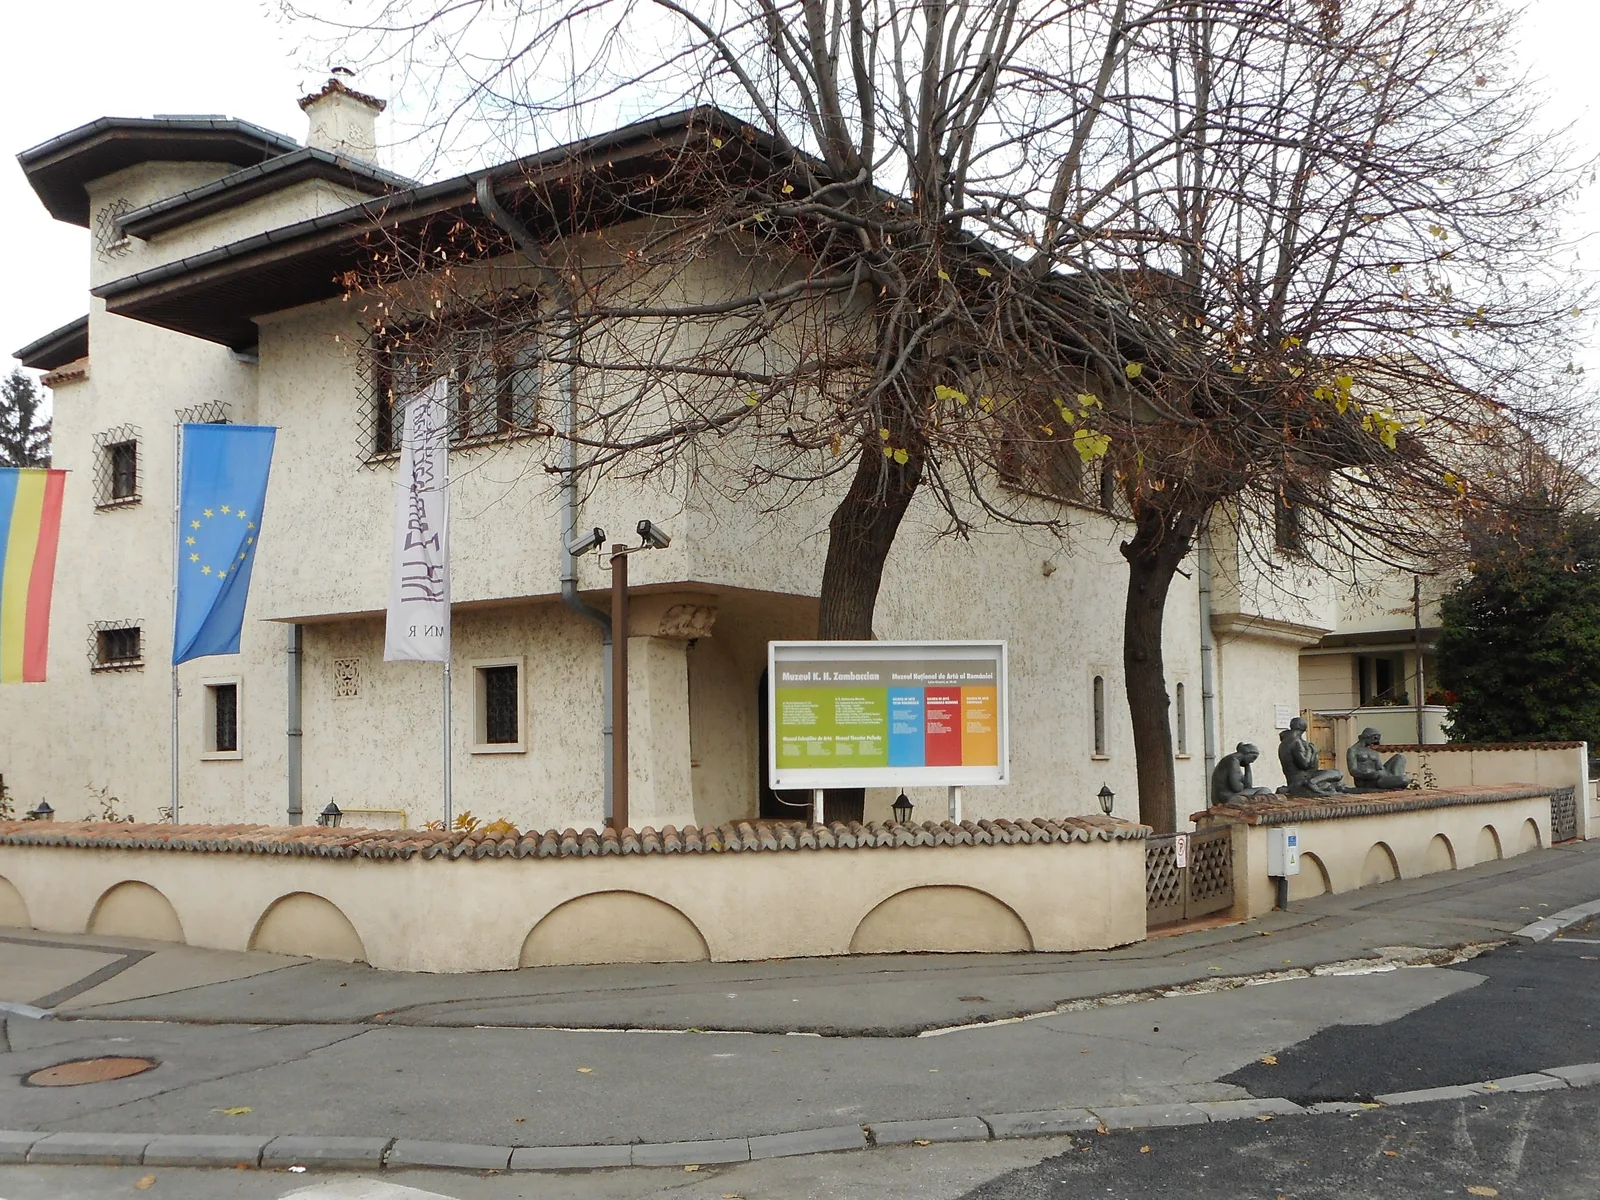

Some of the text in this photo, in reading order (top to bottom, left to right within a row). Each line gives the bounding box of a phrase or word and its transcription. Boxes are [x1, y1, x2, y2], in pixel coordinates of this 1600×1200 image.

[782, 671, 880, 681] Muzeul K. H. Zambaccian
[892, 672, 912, 680] Muzeul
